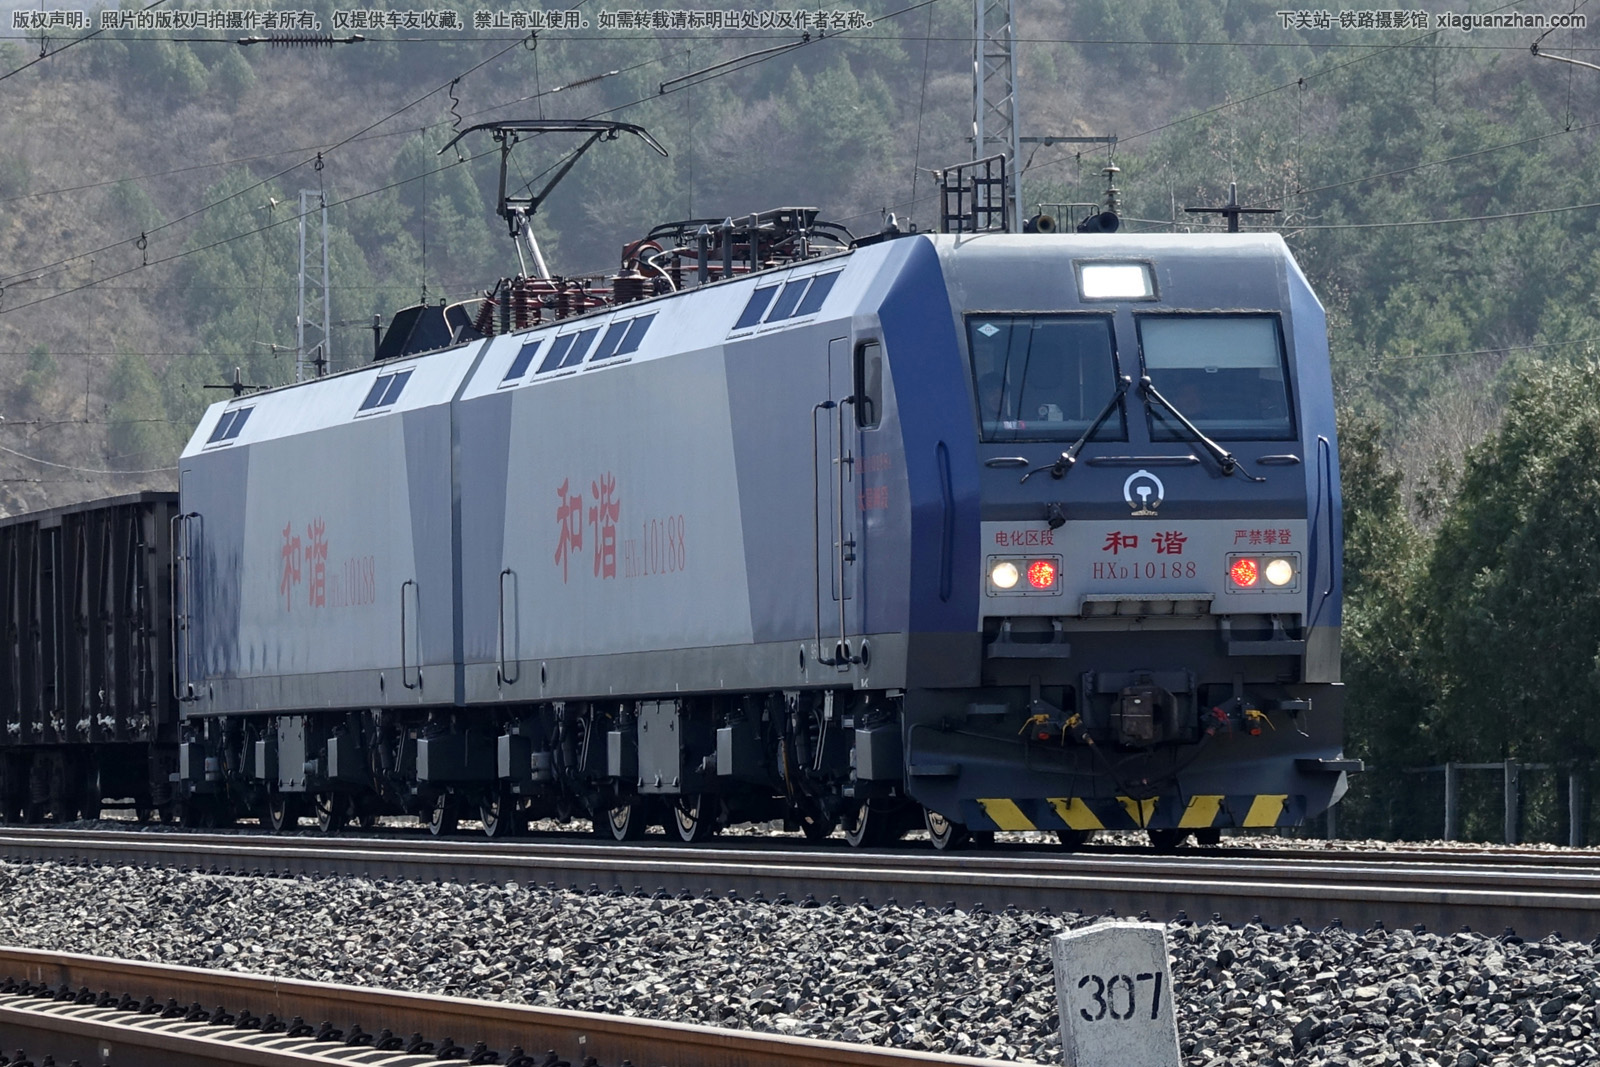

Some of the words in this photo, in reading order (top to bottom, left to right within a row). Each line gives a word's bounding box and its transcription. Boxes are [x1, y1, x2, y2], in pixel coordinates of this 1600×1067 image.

[555, 471, 620, 584] 和谐
[995, 530, 1054, 546] 电化区段
[1233, 529, 1292, 545] 严禁攀登
[1102, 531, 1187, 555] 和谐
[281, 515, 328, 612] 和谐
[1092, 561, 1197, 579] HXD10188
[1078, 972, 1162, 1021] 307
